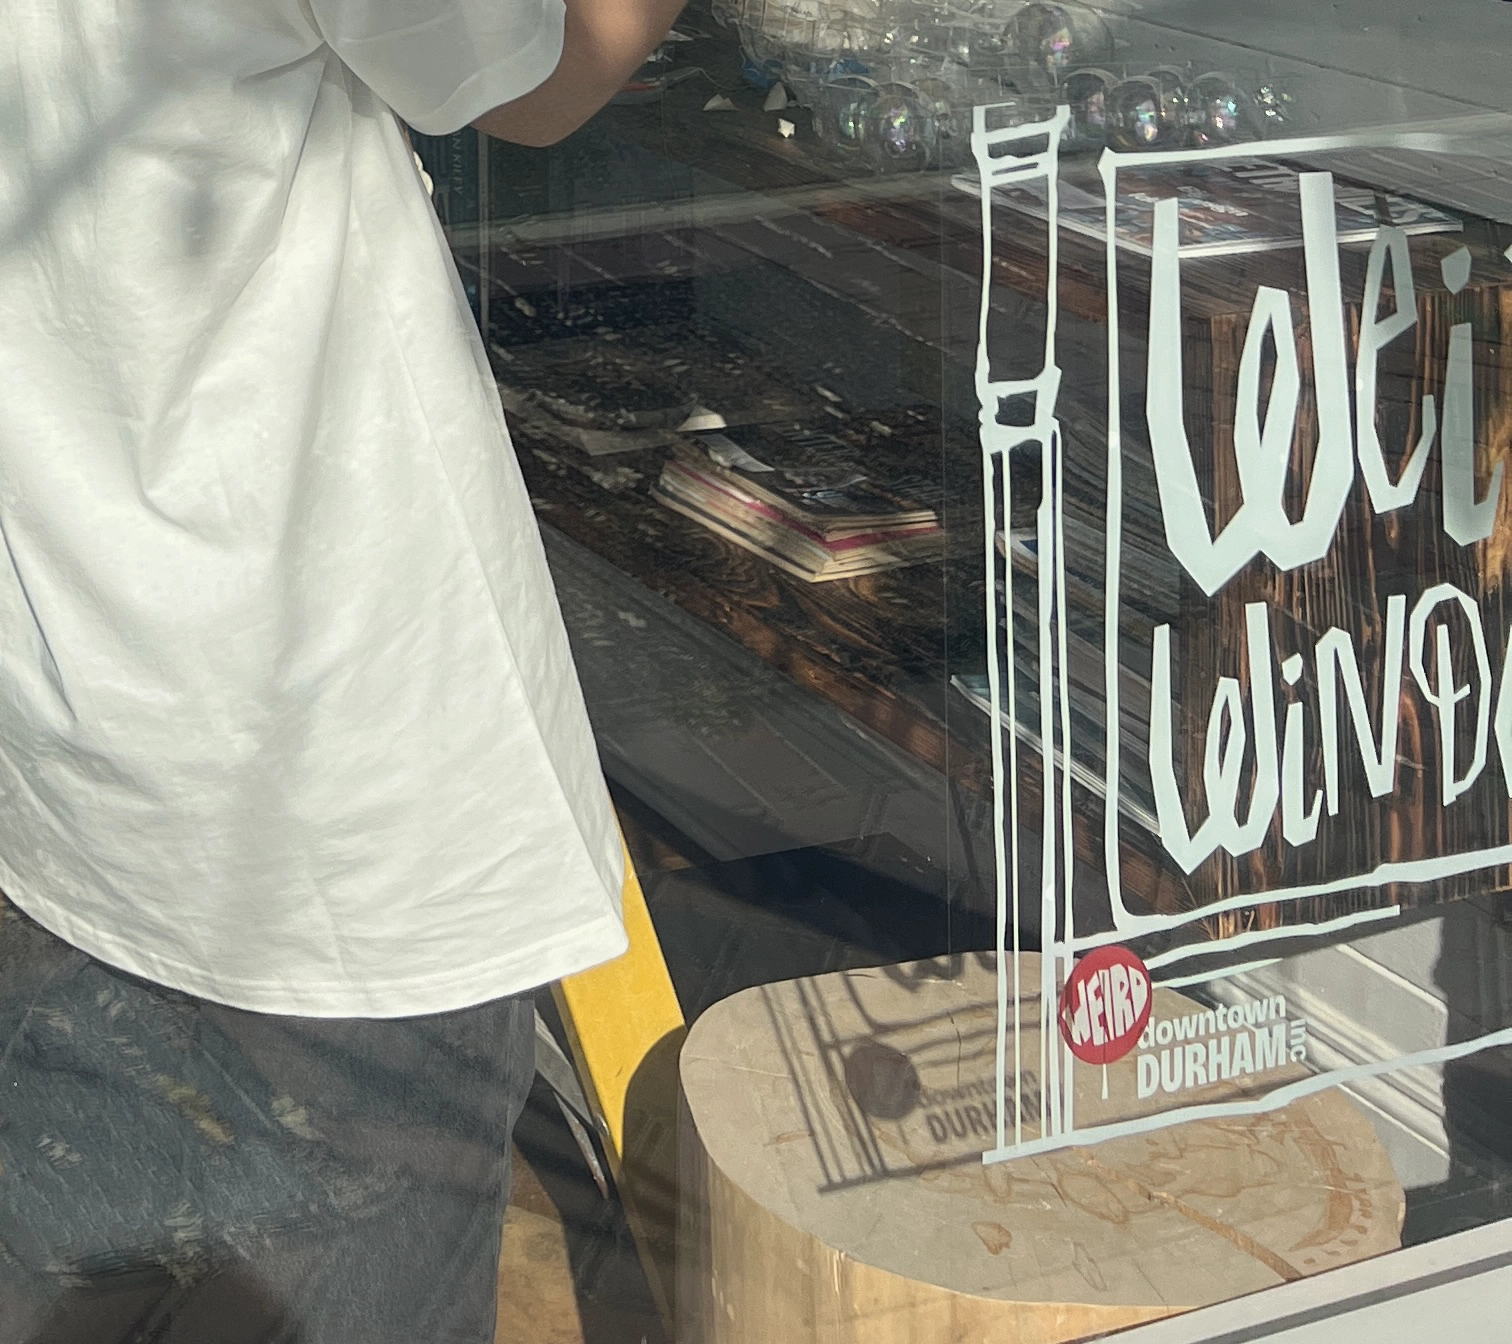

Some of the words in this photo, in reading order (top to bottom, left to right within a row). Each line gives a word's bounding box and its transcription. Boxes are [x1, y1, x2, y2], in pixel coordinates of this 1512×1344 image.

[1146, 171, 1512, 597] Wei
[1062, 963, 1148, 1047] WEIRD
[1138, 995, 1286, 1049] downtown
[1291, 1018, 1308, 1063] inc
[1138, 1023, 1287, 1100] DURHAM
